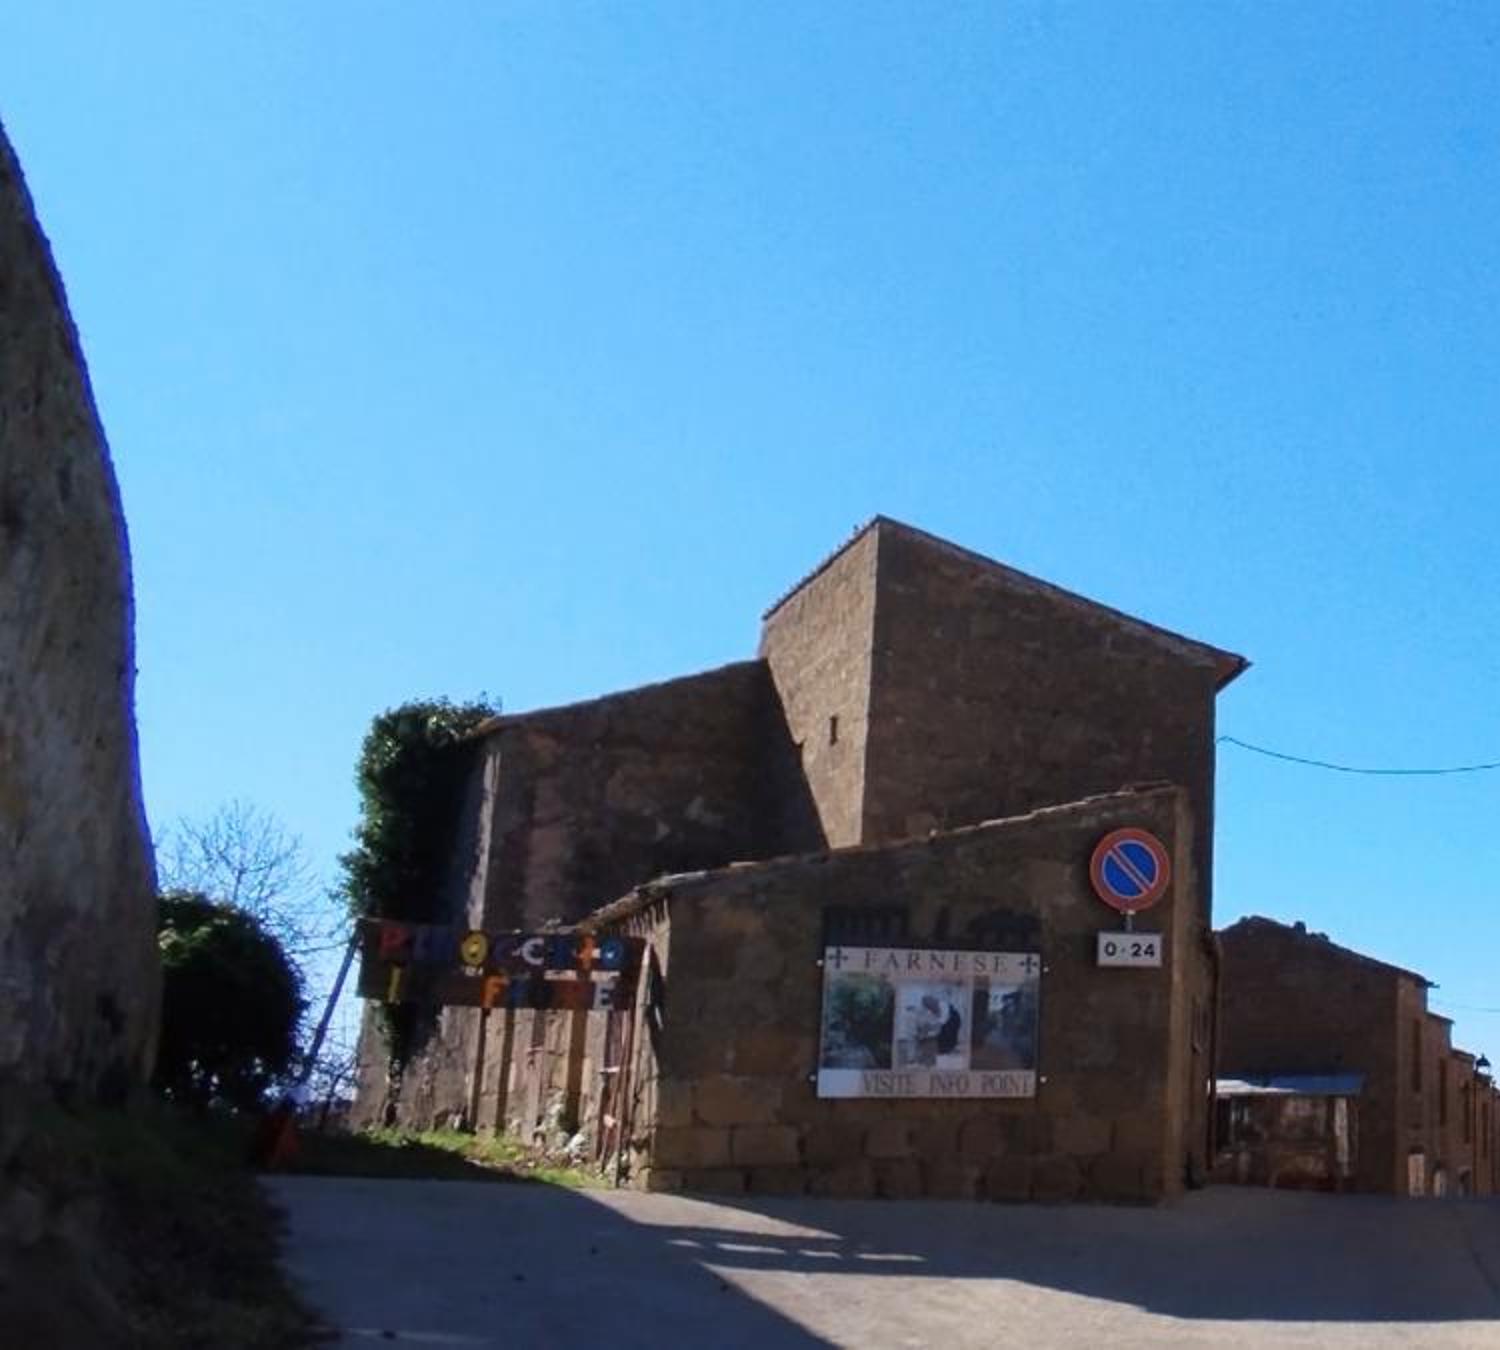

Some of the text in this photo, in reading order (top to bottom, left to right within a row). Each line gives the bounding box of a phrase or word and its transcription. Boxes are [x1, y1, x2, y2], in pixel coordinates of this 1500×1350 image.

[864, 951, 1008, 972] FARNESE
[482, 973, 617, 1010] FIRE
[863, 1071, 1031, 1094] VISITE INFO POINT
